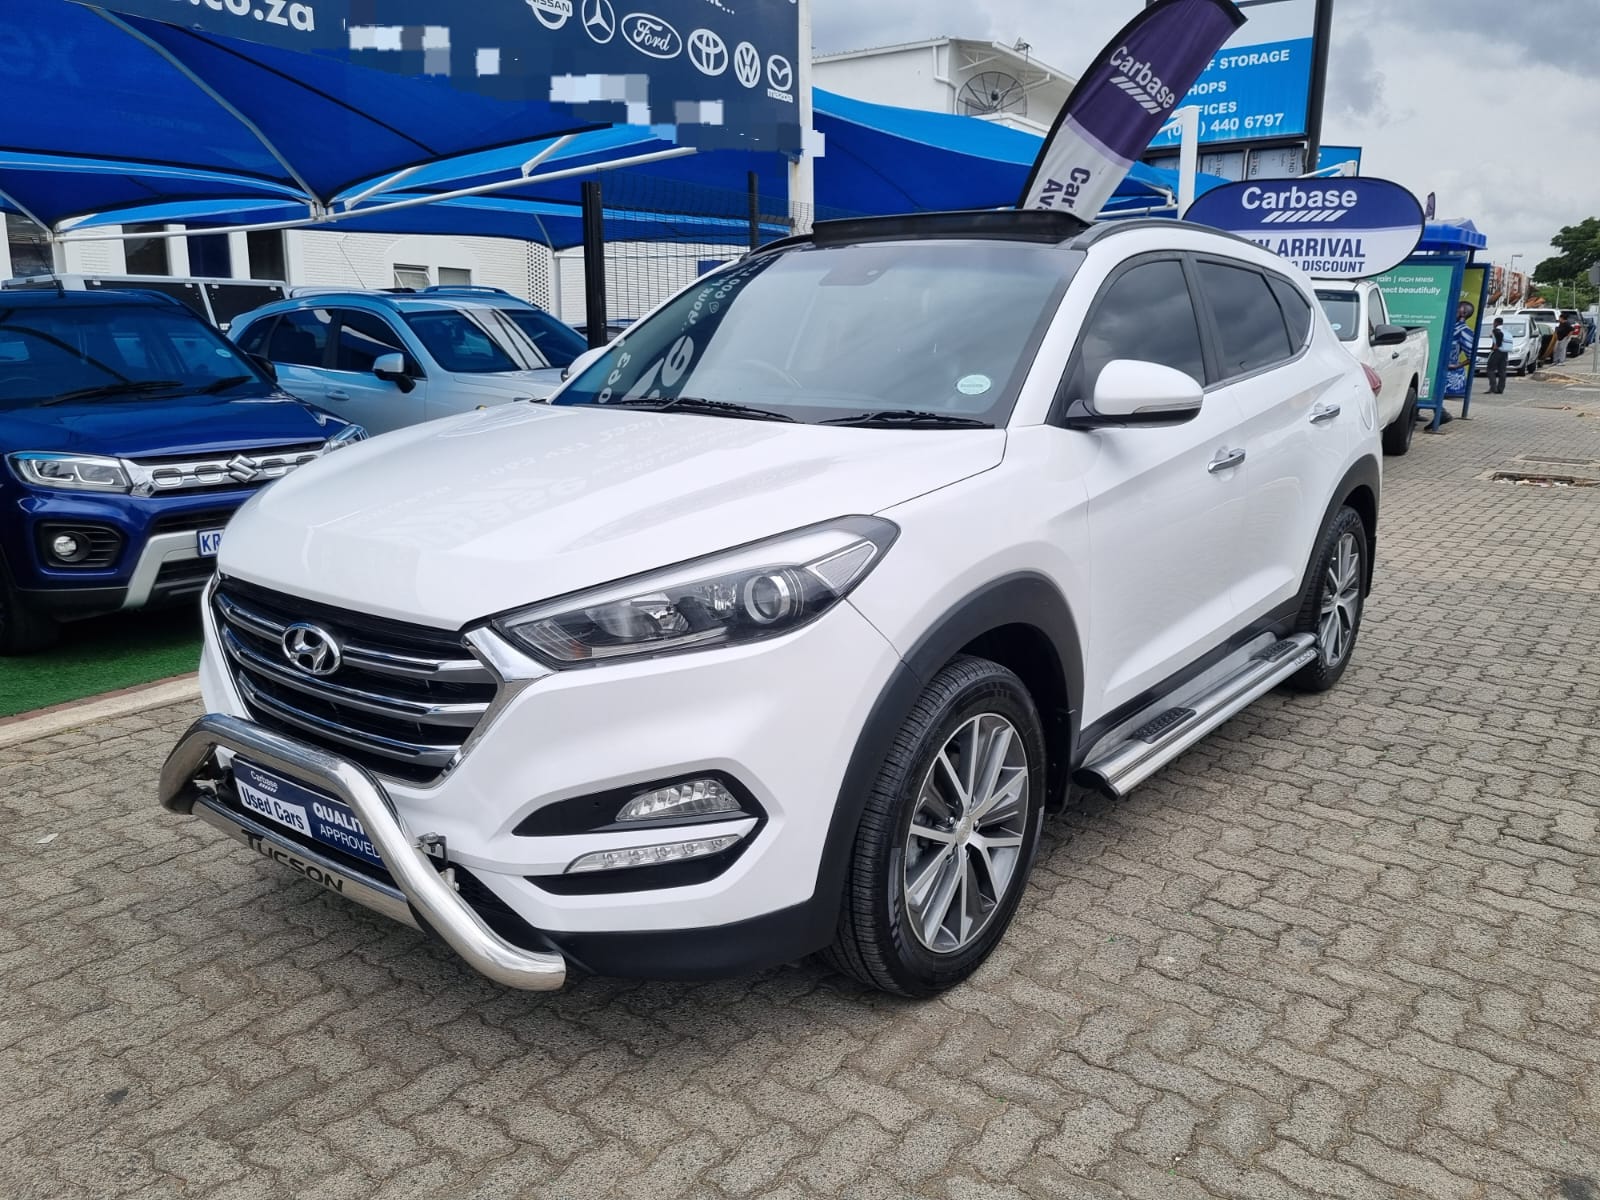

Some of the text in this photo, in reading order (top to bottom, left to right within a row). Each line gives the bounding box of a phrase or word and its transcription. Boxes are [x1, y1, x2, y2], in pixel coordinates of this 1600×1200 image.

[531, 0, 571, 13] SSAN
[633, 19, 672, 51] Ford
[1219, 50, 1290, 71] STORAGE
[1109, 46, 1176, 109] Carbase
[1188, 81, 1227, 96] HOPS
[1210, 117, 1240, 132] 440
[1244, 113, 1284, 128] 6797
[1036, 178, 1064, 209] Av
[1241, 186, 1358, 210] Carbase
[1277, 238, 1366, 258] ARRIVAL
[1302, 260, 1365, 273] DISCOUNT
[1398, 286, 1441, 296] beautifully
[201, 533, 221, 553] KR
[241, 786, 305, 831] Used Cars
[312, 801, 365, 836] QUALIT
[241, 829, 344, 893] TUCSON
